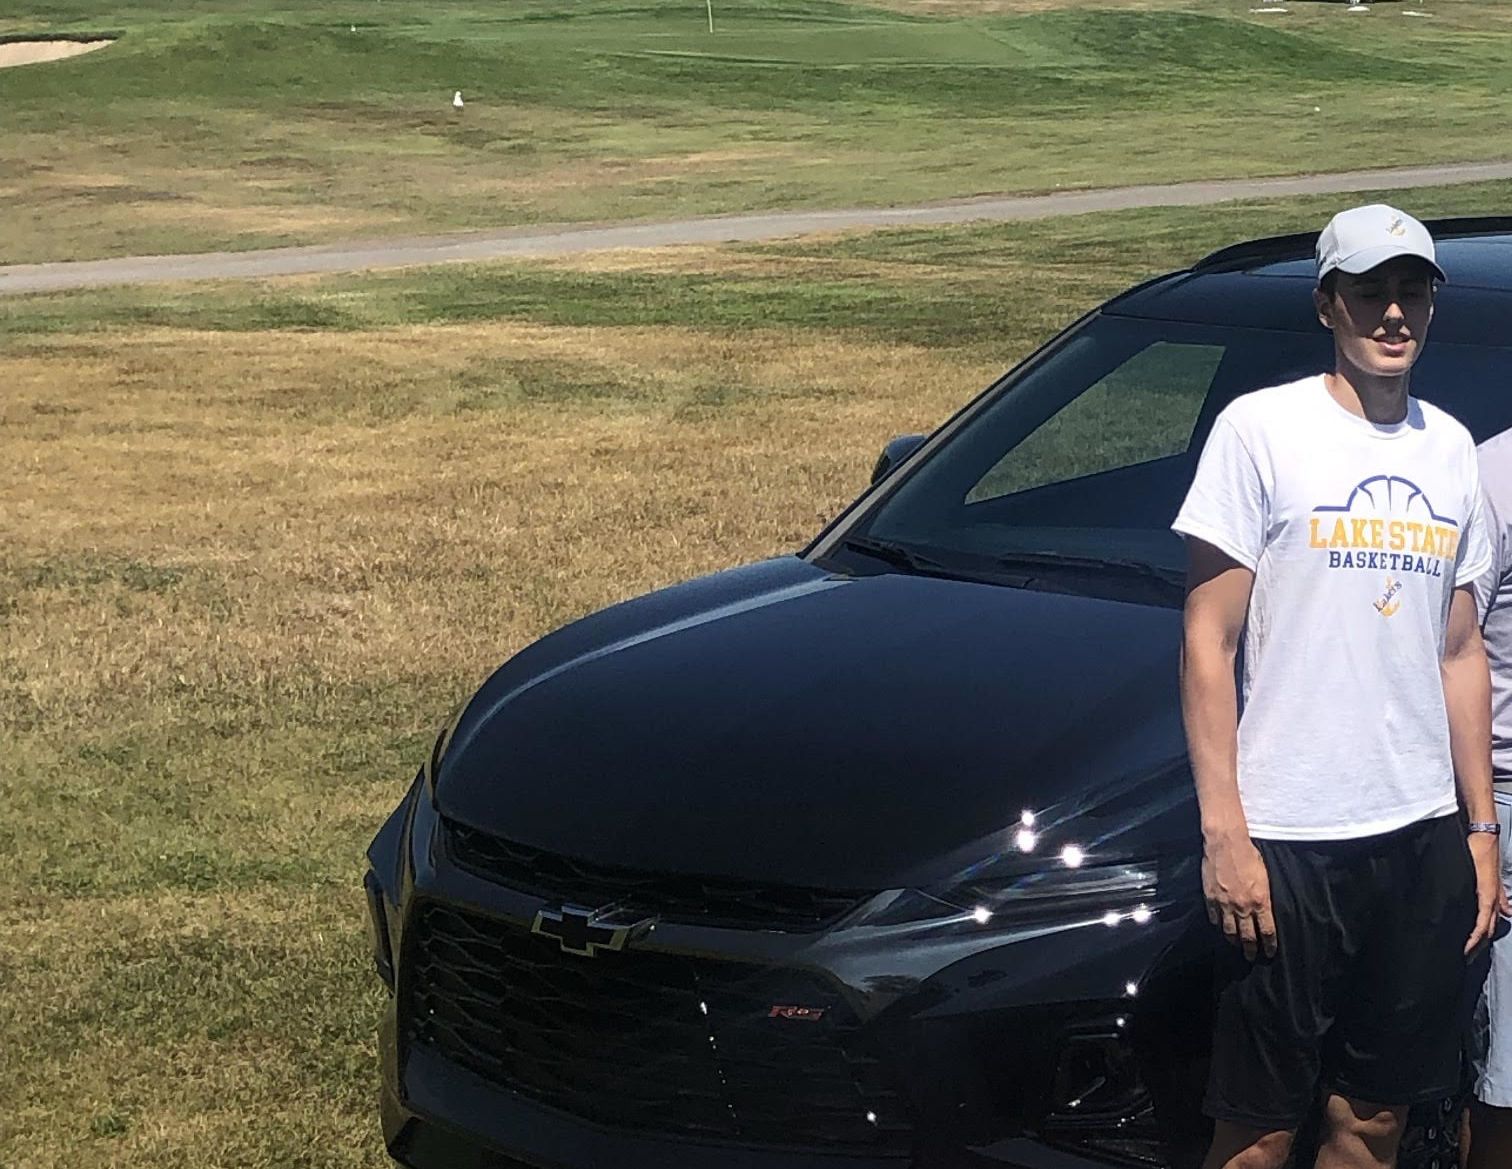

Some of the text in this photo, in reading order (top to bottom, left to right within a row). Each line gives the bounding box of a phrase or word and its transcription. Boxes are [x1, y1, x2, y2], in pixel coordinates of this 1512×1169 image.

[1309, 517, 1460, 561] LAKE STATE
[1329, 551, 1441, 577] BASKETBALL
